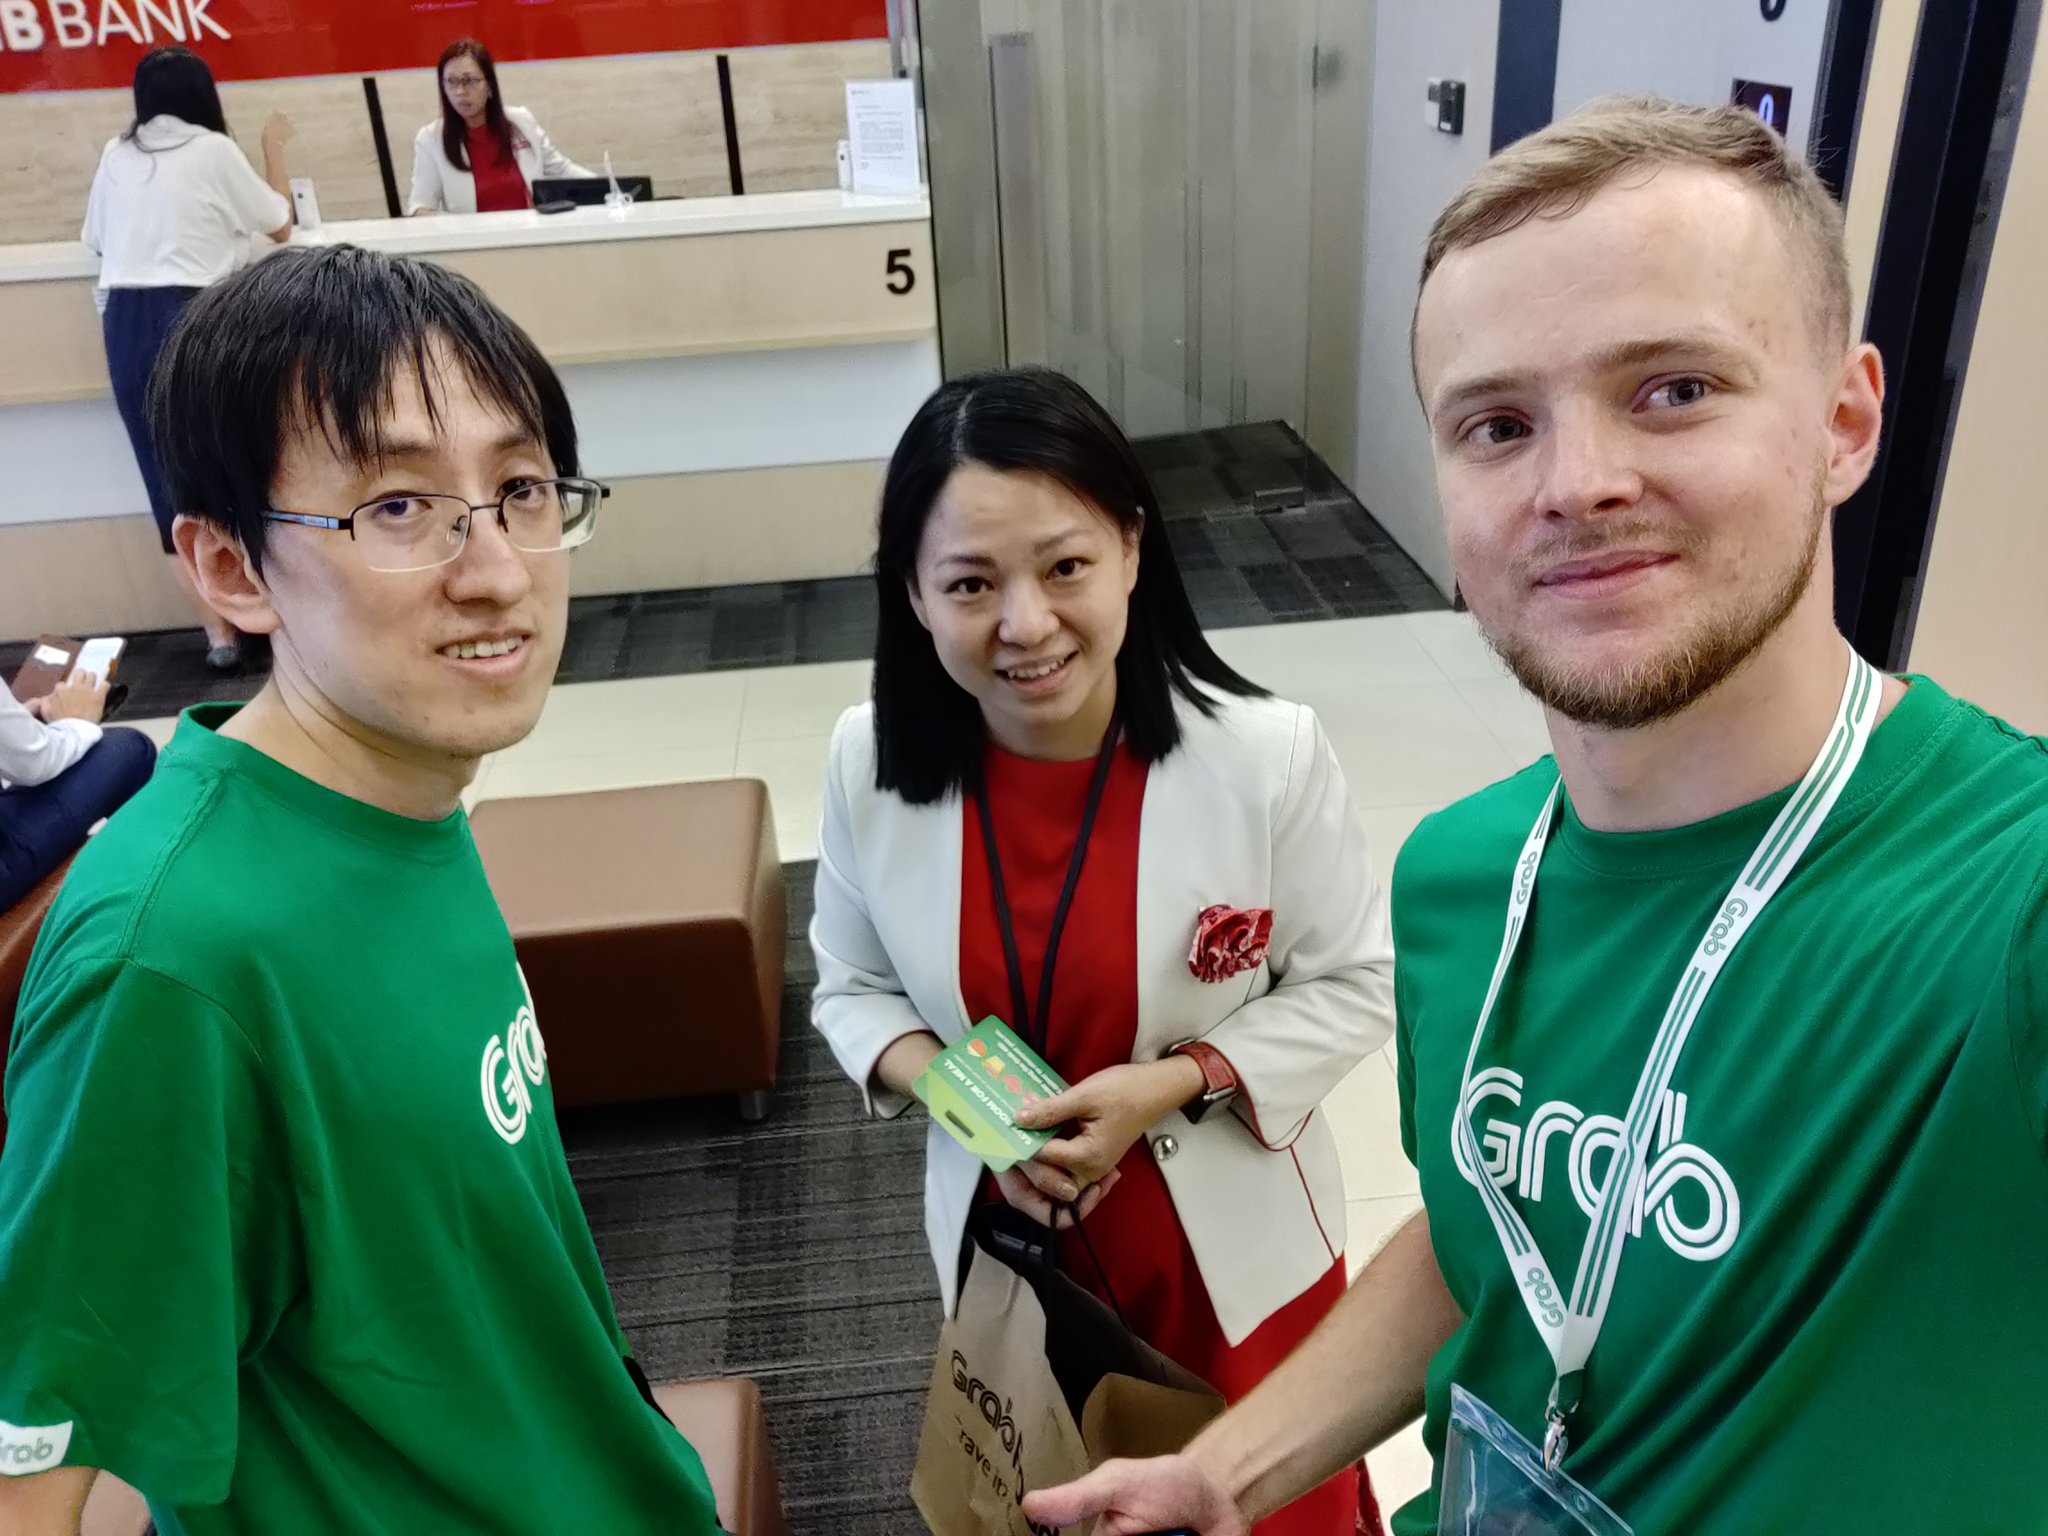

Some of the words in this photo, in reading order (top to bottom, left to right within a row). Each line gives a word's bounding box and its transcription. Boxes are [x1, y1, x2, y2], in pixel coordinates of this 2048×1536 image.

[48, 0, 232, 48] BANK
[886, 248, 916, 295] 5
[1515, 851, 1538, 905] Grab
[1703, 898, 1748, 956] Grab
[1450, 1066, 1741, 1262] Grab
[1523, 1267, 1564, 1328] Grab
[0, 1436, 54, 1465] rab
